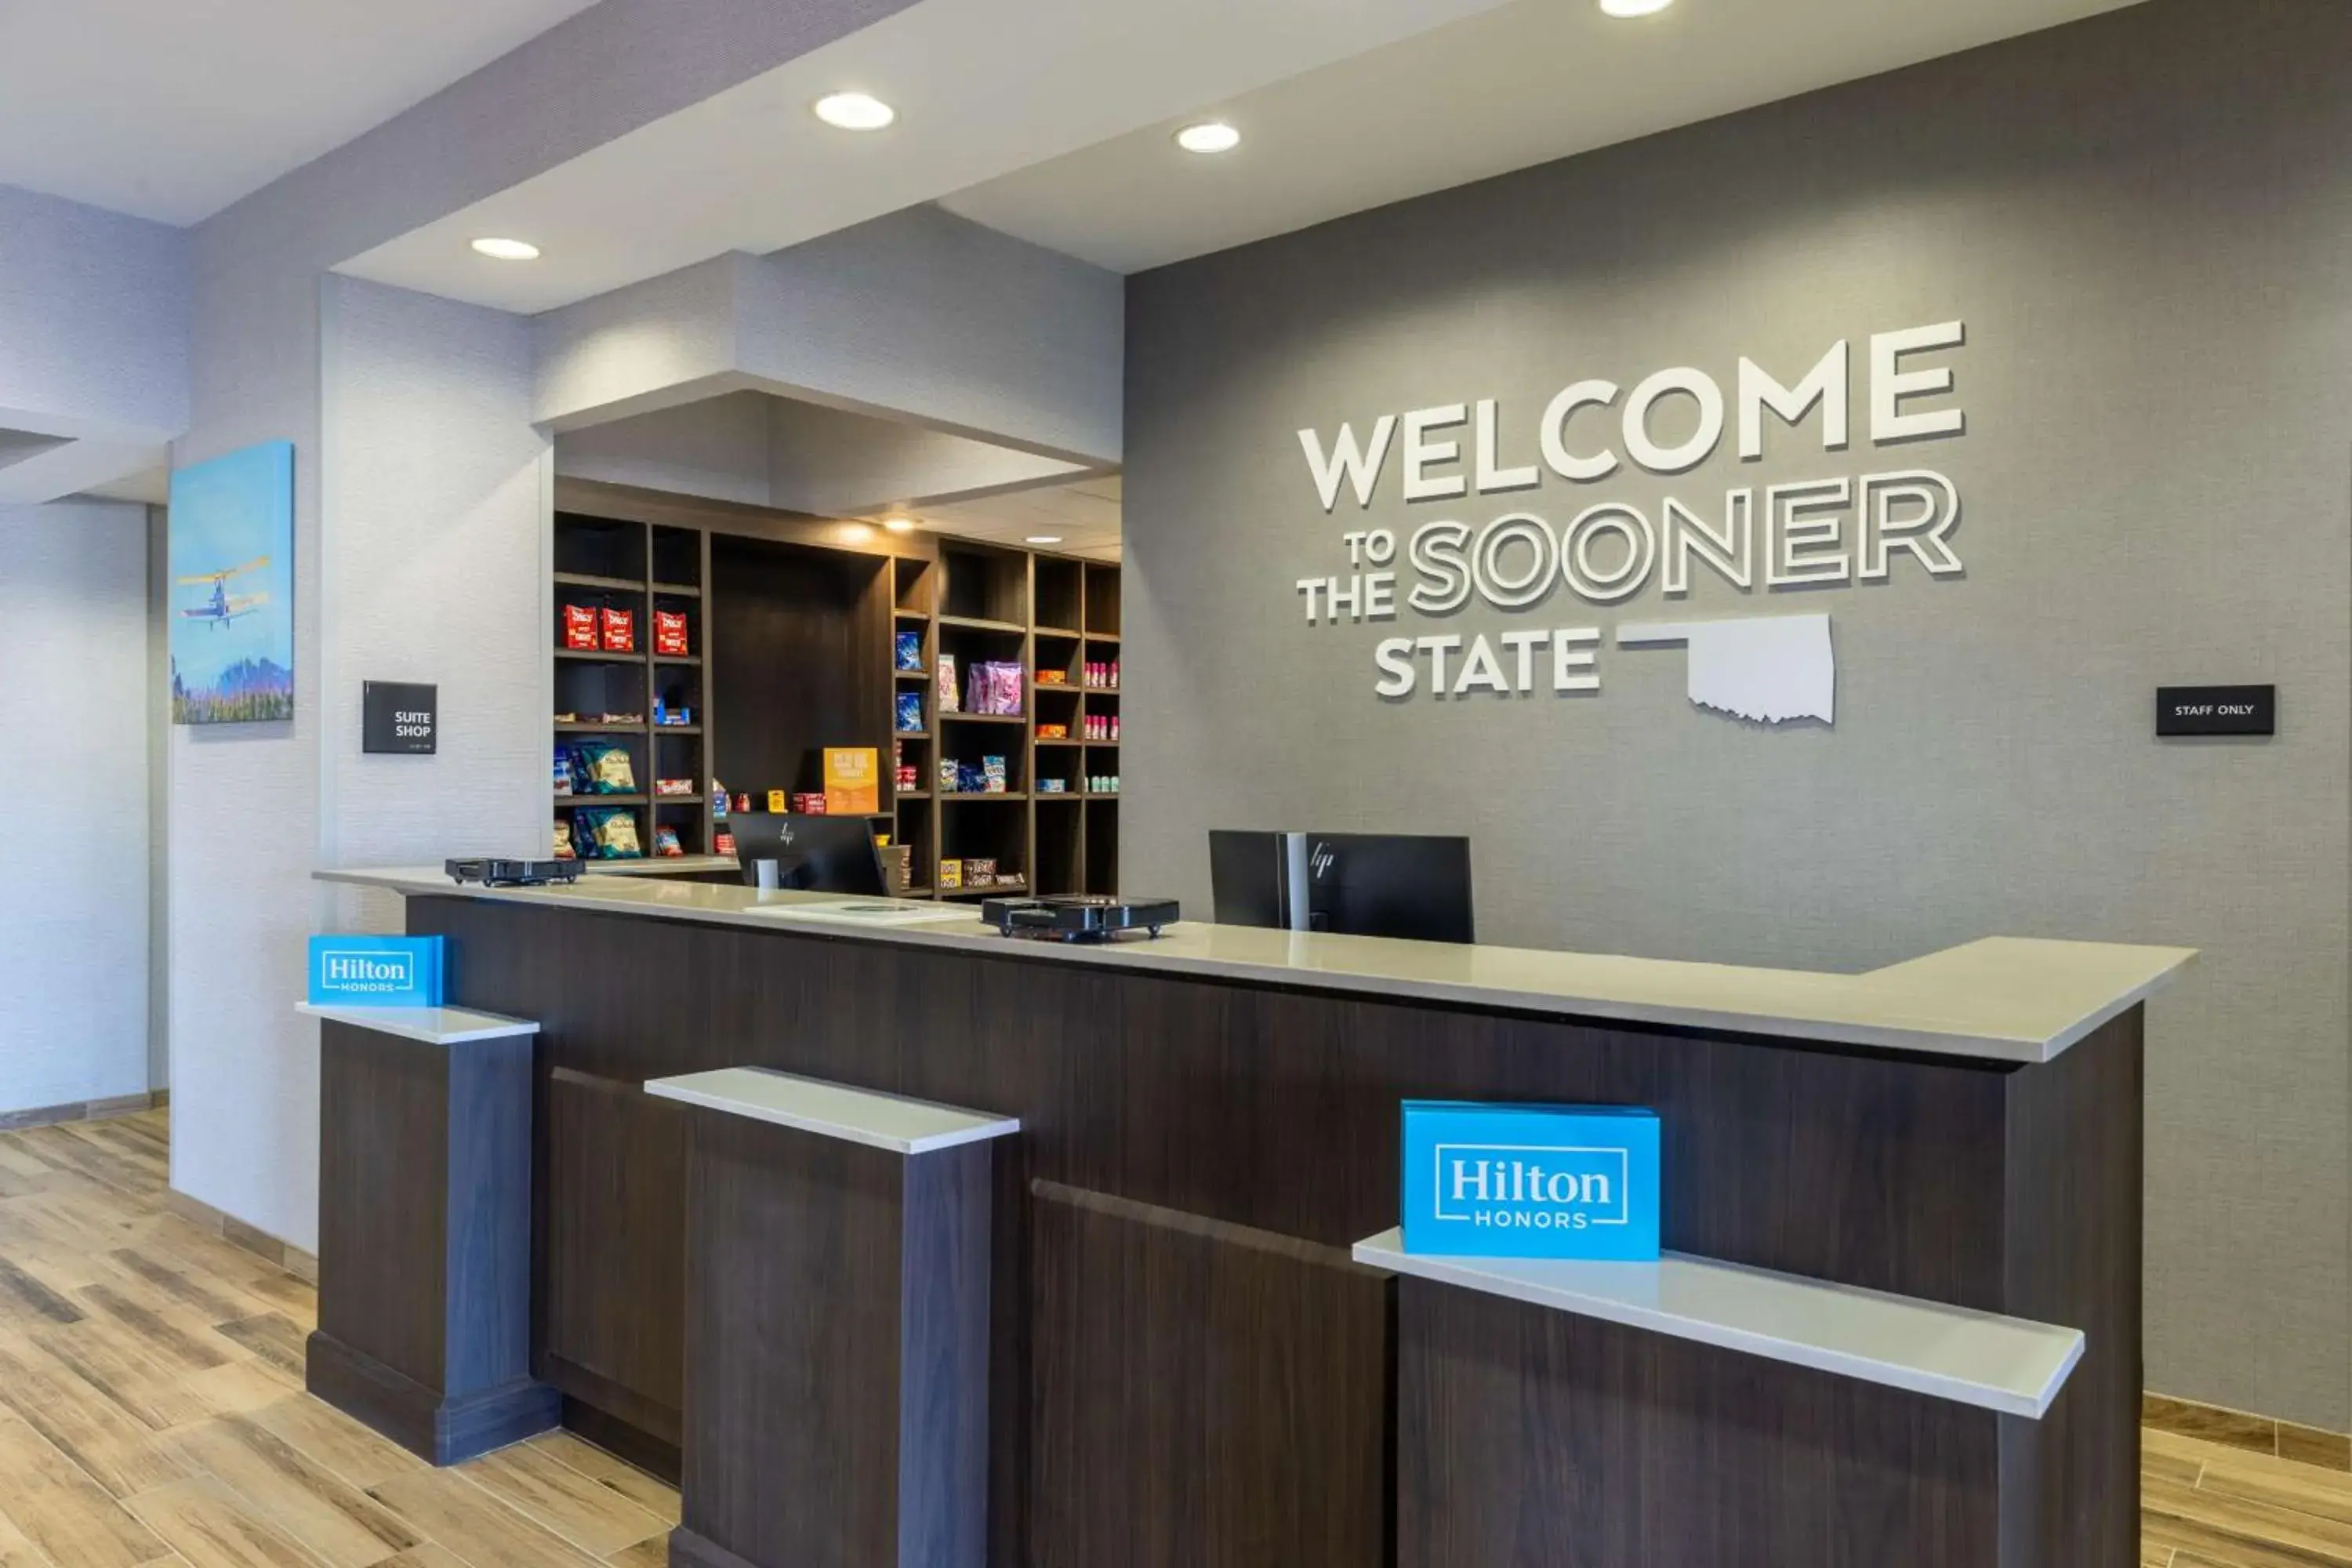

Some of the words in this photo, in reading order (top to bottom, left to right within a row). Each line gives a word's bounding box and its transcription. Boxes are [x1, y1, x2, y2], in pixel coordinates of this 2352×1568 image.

[1297, 320, 1965, 512] WELCOME
[1344, 529, 1395, 564] TO
[1408, 470, 1963, 612] SOONER
[1297, 572, 1396, 622] THE
[1375, 627, 1601, 698] STATE
[394, 711, 430, 724] SUITE
[2176, 706, 2214, 716] STAFF
[2218, 704, 2255, 716] ONLY
[396, 725, 431, 737] SHOP
[1310, 841, 1334, 878] hp
[330, 958, 405, 979] Hilton
[340, 982, 394, 992] HONORS
[1451, 1160, 1611, 1203] Hilton
[1475, 1210, 1588, 1229] HONORS
